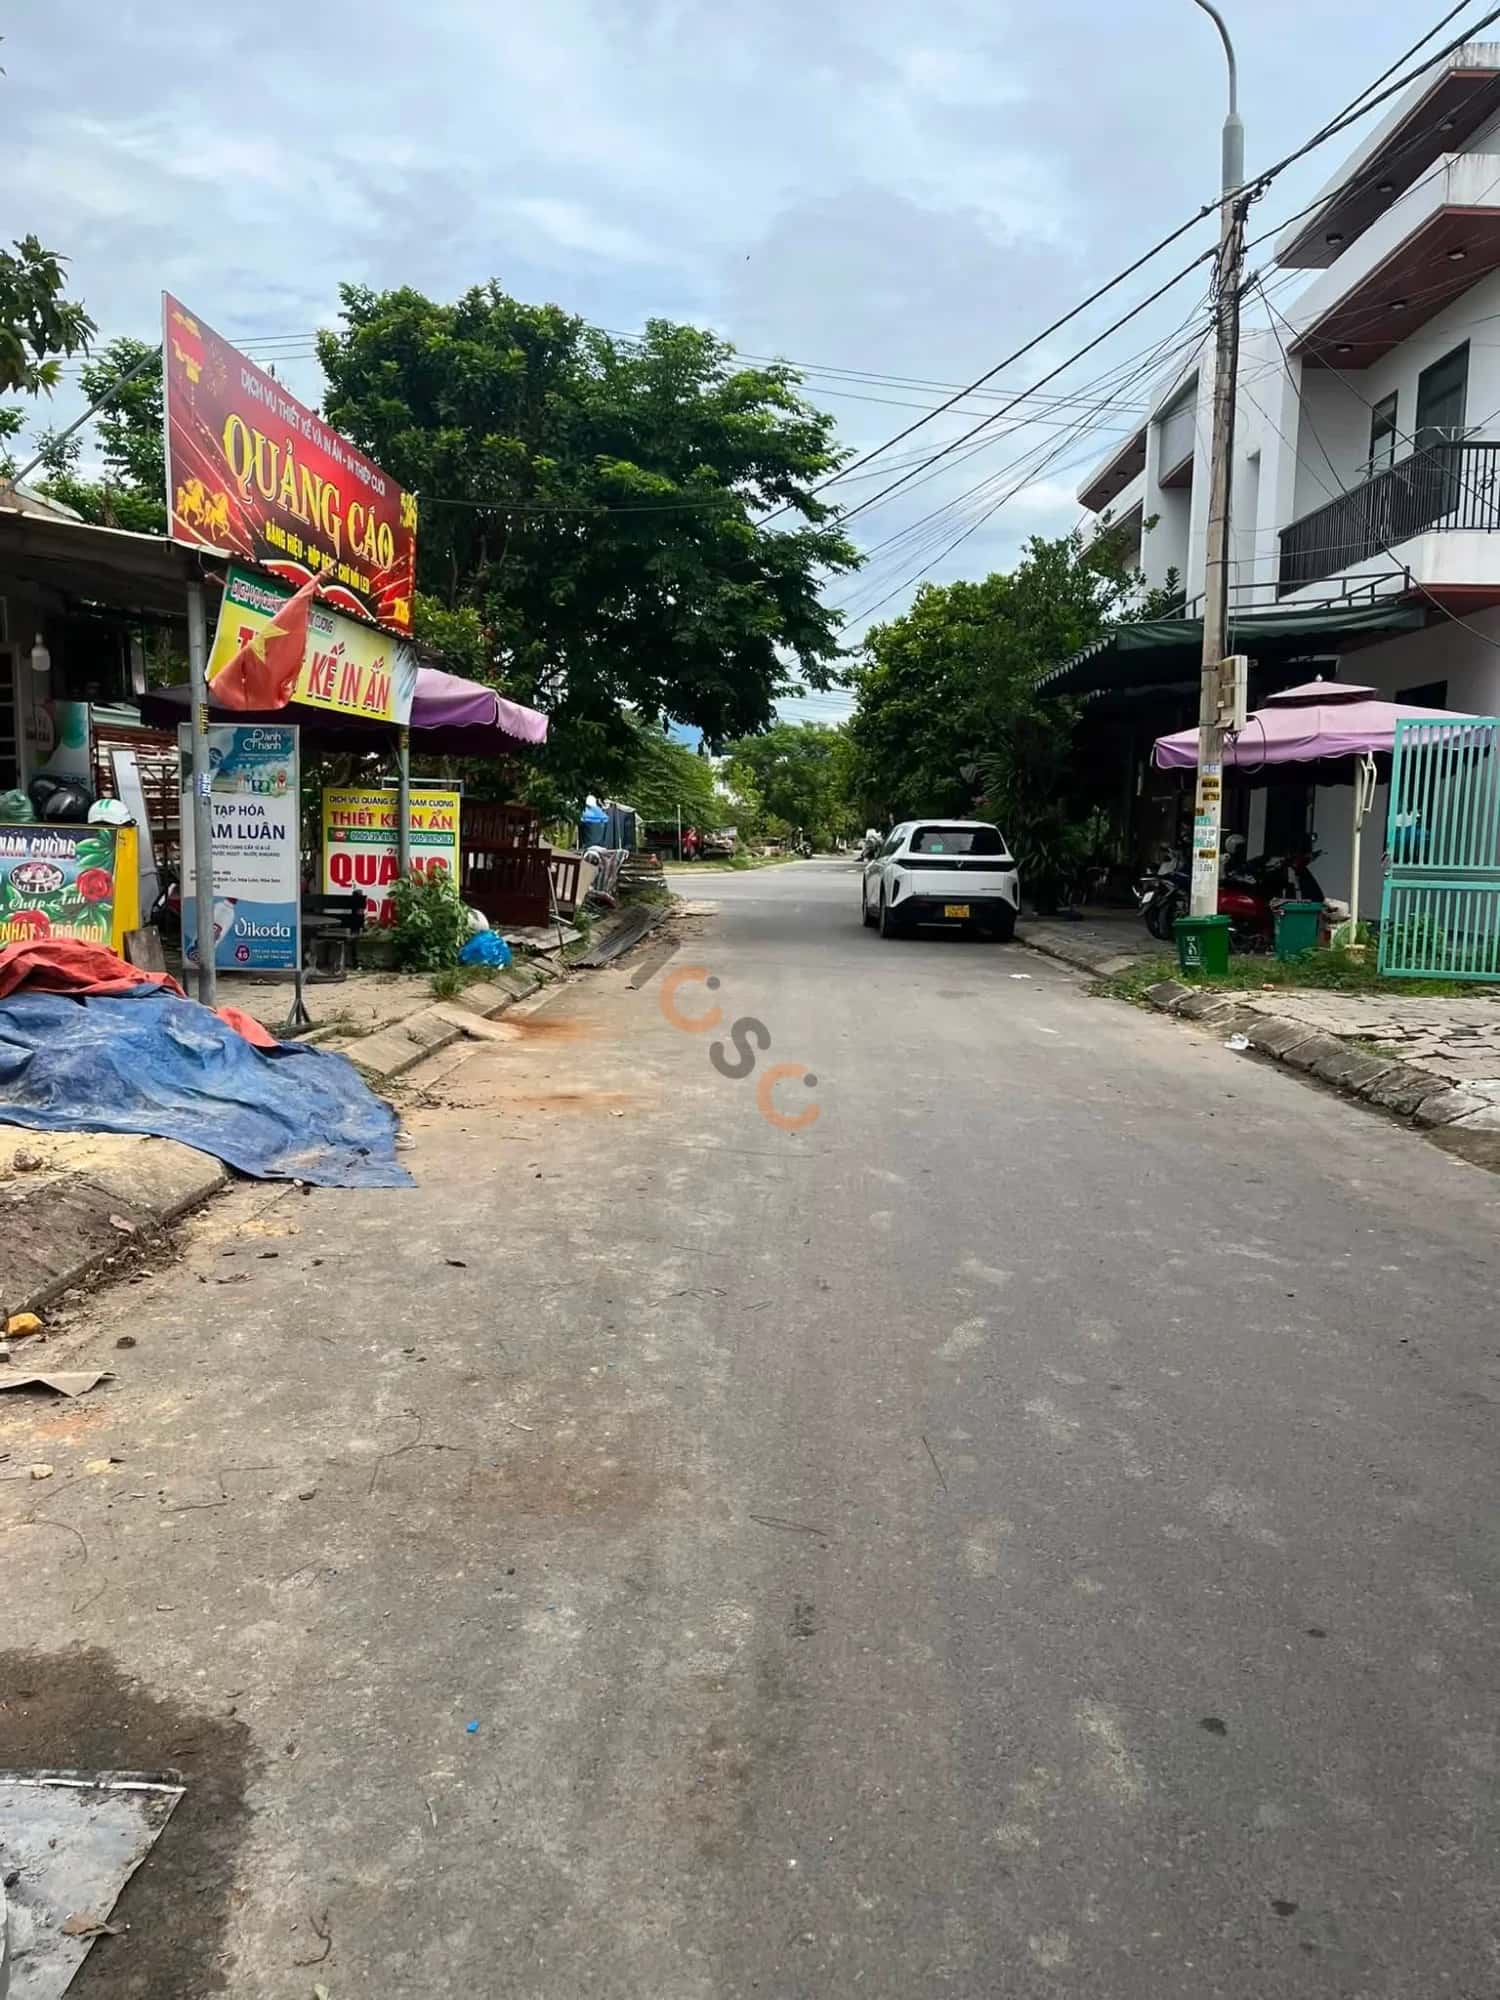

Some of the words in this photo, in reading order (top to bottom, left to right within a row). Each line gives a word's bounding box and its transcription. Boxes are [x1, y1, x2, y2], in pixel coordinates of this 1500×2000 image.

[223, 414, 342, 558] QUẢNG
[347, 502, 394, 573] CÁO
[307, 641, 345, 702] KẾ
[338, 661, 363, 708] IN
[361, 656, 391, 714] ẤN
[213, 805, 236, 819] TẠP
[238, 803, 265, 817] HÓA
[331, 807, 375, 826] THIẾT
[428, 809, 453, 830] ẤN
[238, 821, 286, 840] LUÂN
[234, 917, 292, 938] Vikoda
